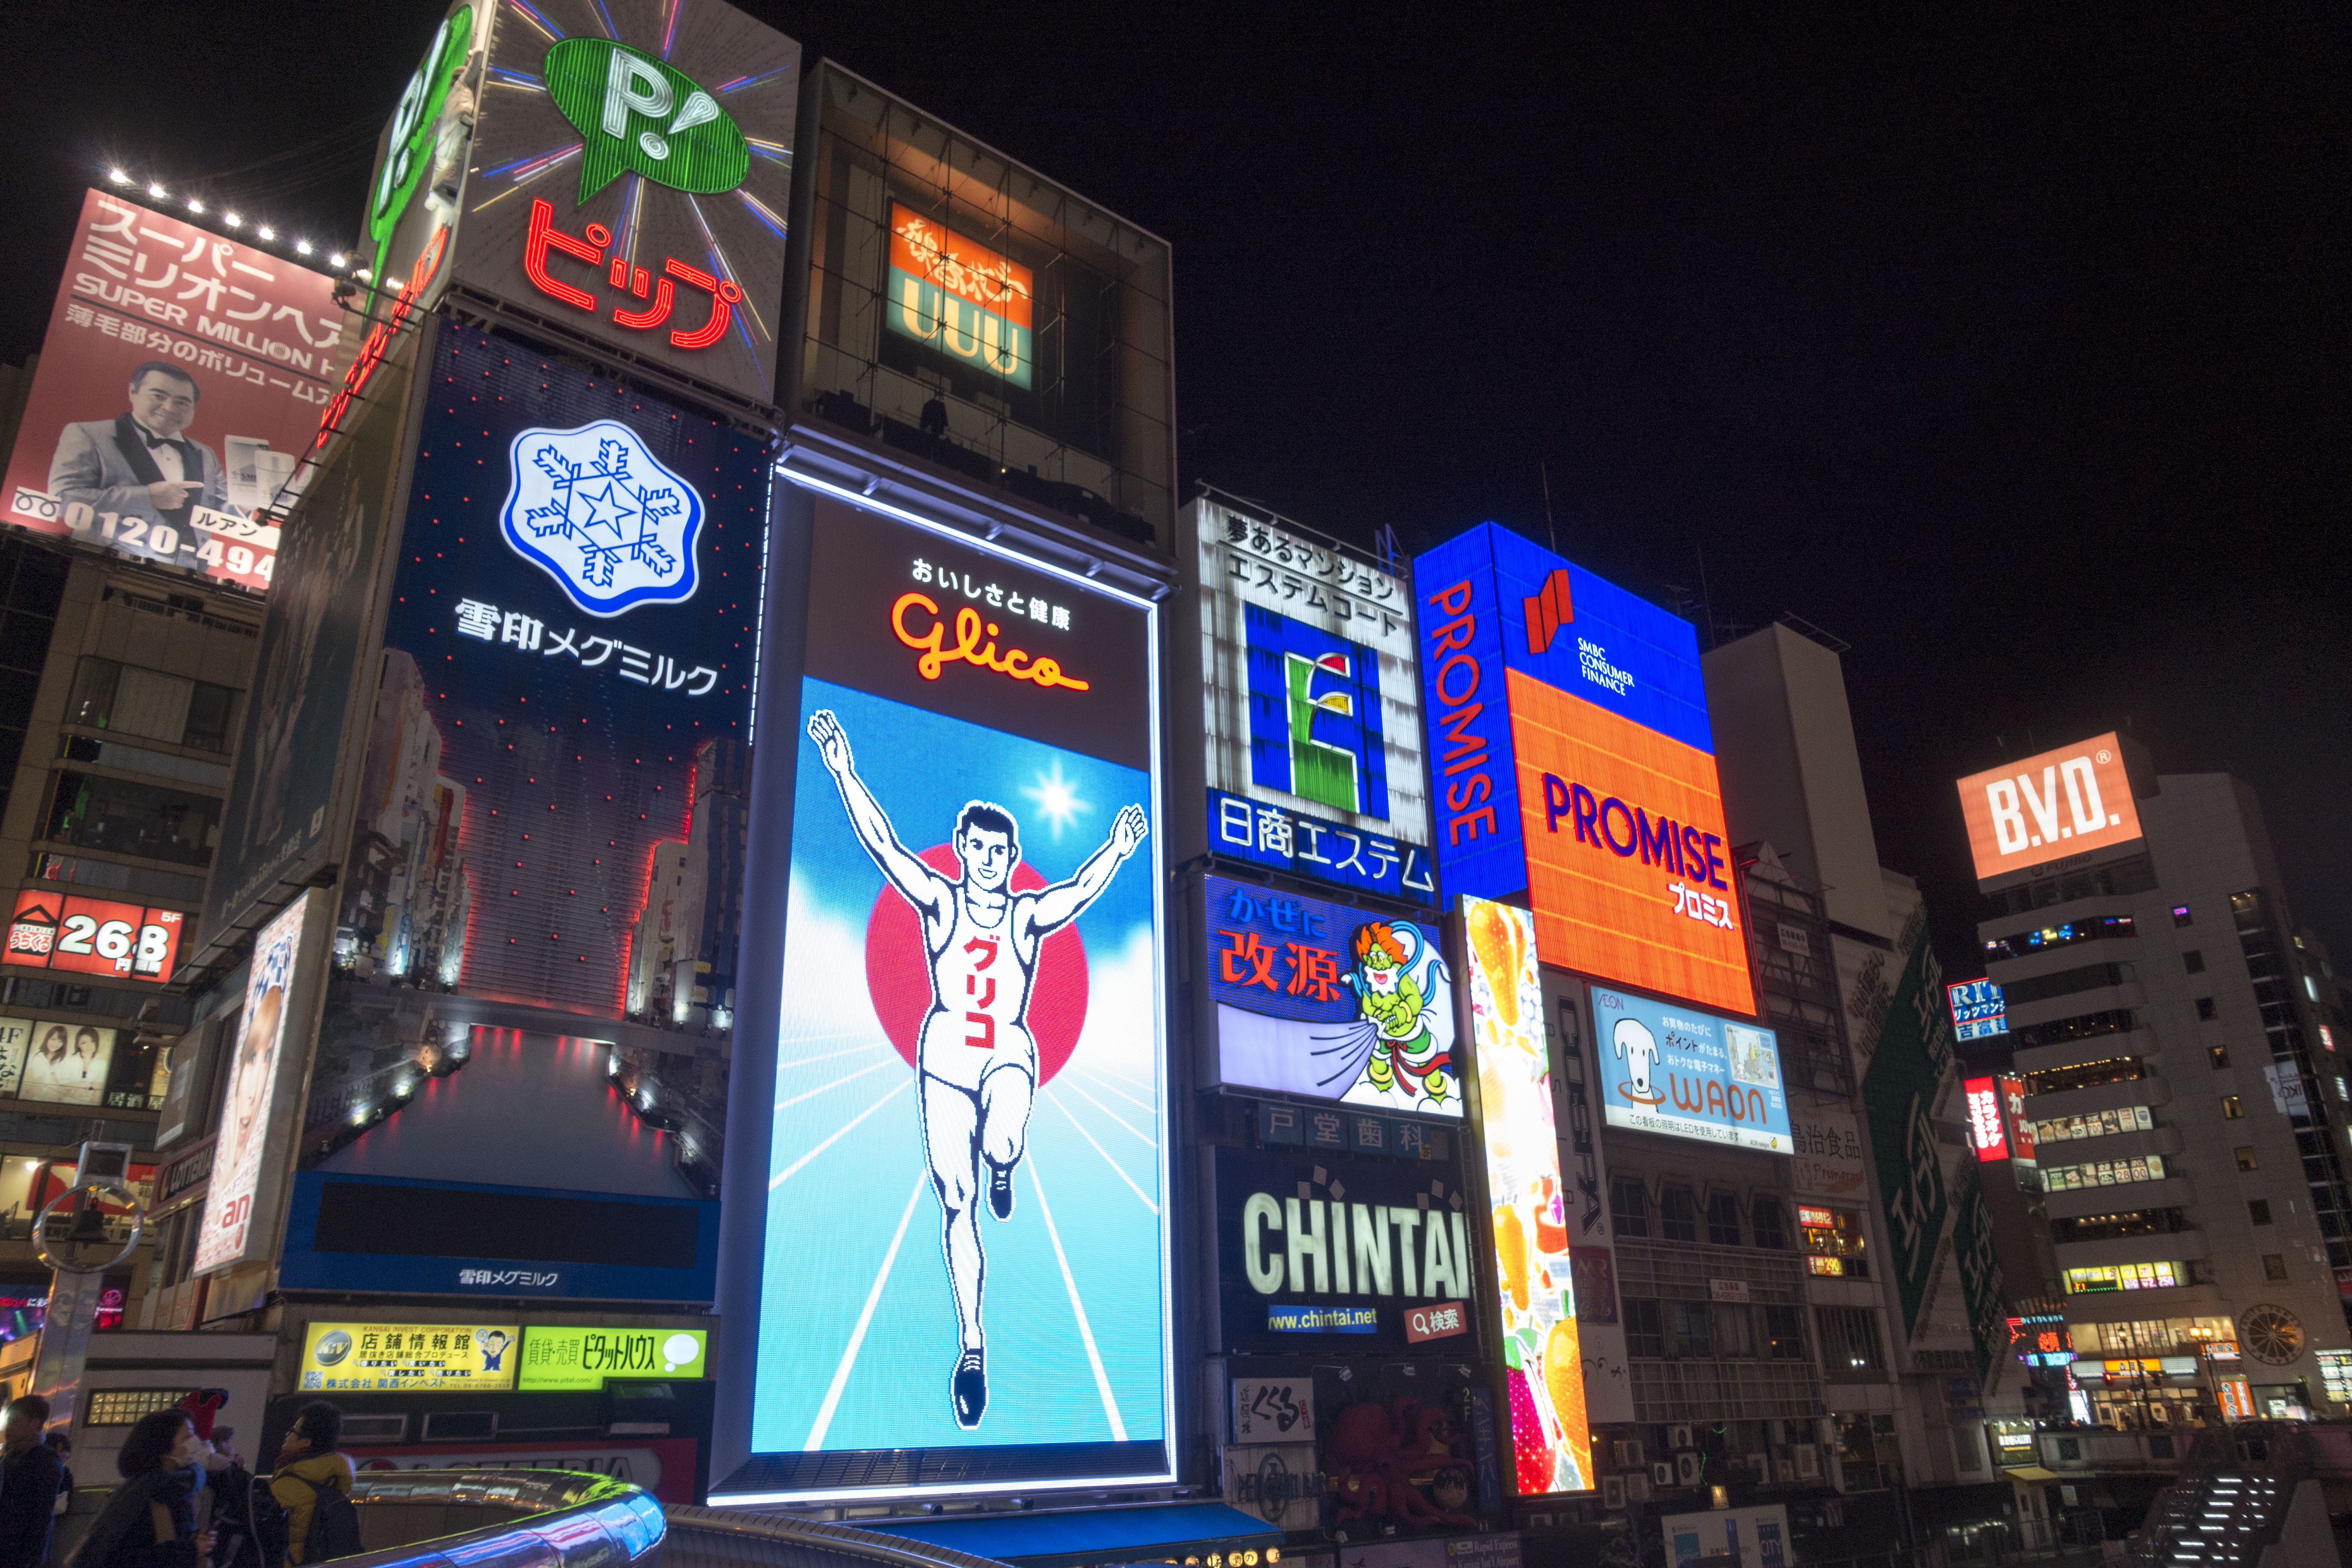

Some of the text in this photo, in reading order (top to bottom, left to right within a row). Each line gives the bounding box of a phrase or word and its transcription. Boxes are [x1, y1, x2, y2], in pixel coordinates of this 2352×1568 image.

[90, 200, 274, 282] スーパー
[524, 196, 742, 349] ピップ
[73, 273, 187, 326] SUPER
[197, 315, 312, 376] MILLION
[197, 512, 257, 536] ルアン
[912, 558, 1070, 631] おいしさと健康
[1229, 553, 1397, 637] エステムコート
[455, 597, 718, 695] 雪印メグミルク
[891, 592, 1089, 691] Glico
[1578, 637, 1605, 661] SMBC
[1578, 651, 1635, 688] CONSUMER
[1582, 666, 1626, 696] FINANCE
[1429, 579, 1497, 846] PROMISE
[1986, 755, 2121, 855] B.V.D.
[1219, 797, 1434, 892] 日商エステム
[1542, 772, 1727, 892] PROMISE
[161, 912, 181, 923] 5F
[1228, 887, 1328, 939] かぜに
[1669, 882, 1734, 931] プロミス
[9, 930, 52, 952] うちくる
[1219, 929, 1341, 1002] 改源
[963, 934, 1000, 1050] グリコ
[1662, 1016, 1712, 1037] お買物のたびに
[1667, 1054, 1725, 1075] おトクな電子マネー
[1670, 1072, 1767, 1124] WAON
[1980, 1090, 2003, 1146] カラオケ
[1629, 1113, 1743, 1142] この看板の照明はLEDを使用しています。
[221, 1194, 250, 1229] an
[1244, 1192, 1470, 1298] CHINTAI
[459, 1269, 558, 1286] 雪印メグミルク
[1430, 1308, 1460, 1332] 検索
[358, 1351, 469, 1359] 居抜き店舗総合プロデュース
[361, 1333, 472, 1351] 店舗情報館
[527, 1338, 580, 1366] 賃貸・売買
[583, 1334, 655, 1370] ピタットハウス
[326, 1378, 446, 1389] 株式会社 関西インベスト
[1463, 1387, 1471, 1421] 2F
[1251, 1385, 1300, 1433] くくる
[1474, 1540, 1493, 1555] Rapid
[1494, 1539, 1518, 1554] Express
